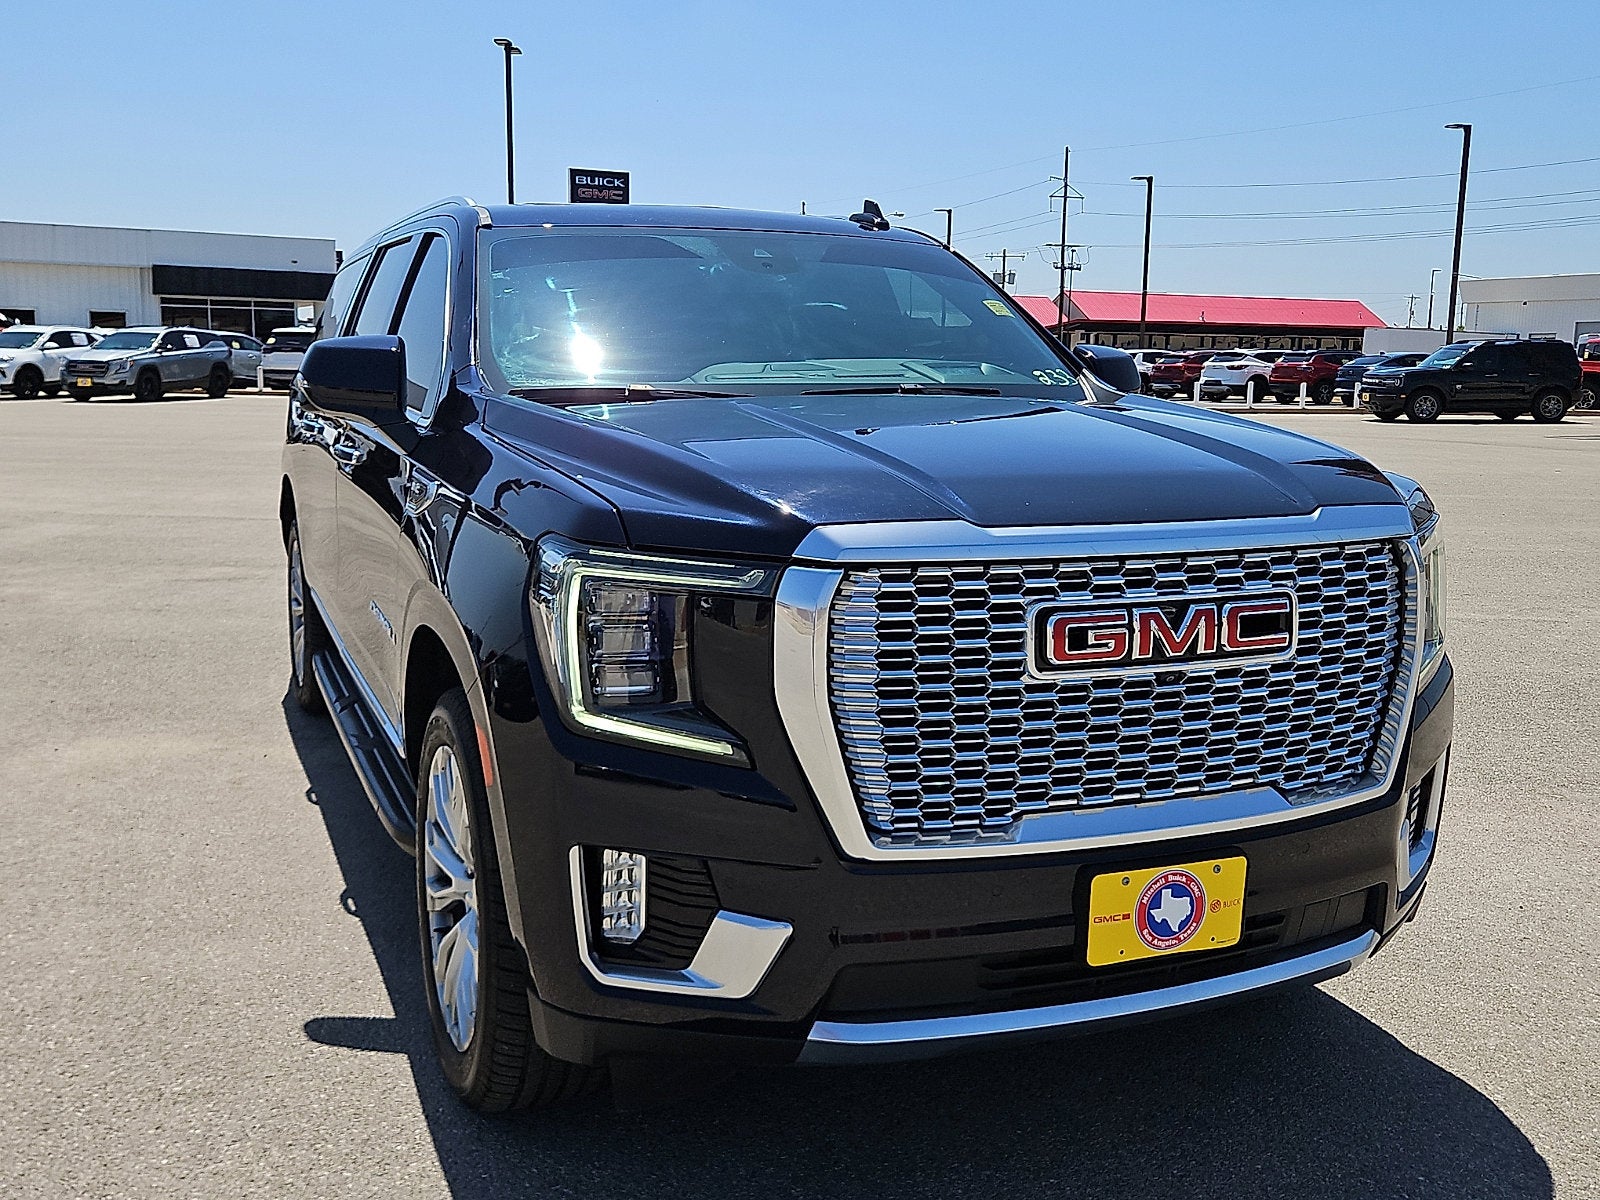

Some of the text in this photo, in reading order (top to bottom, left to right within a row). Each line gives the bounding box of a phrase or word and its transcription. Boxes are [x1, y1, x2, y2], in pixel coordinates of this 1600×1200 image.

[575, 176, 625, 187] BUICK
[577, 188, 624, 200] GMC
[1047, 598, 1290, 664] GMC
[1142, 875, 1201, 904] Mitchell Buick GMC
[1222, 898, 1241, 908] BUICK
[1093, 914, 1121, 923] GMC
[1142, 928, 1153, 942] San
[1179, 922, 1197, 940] Texas
